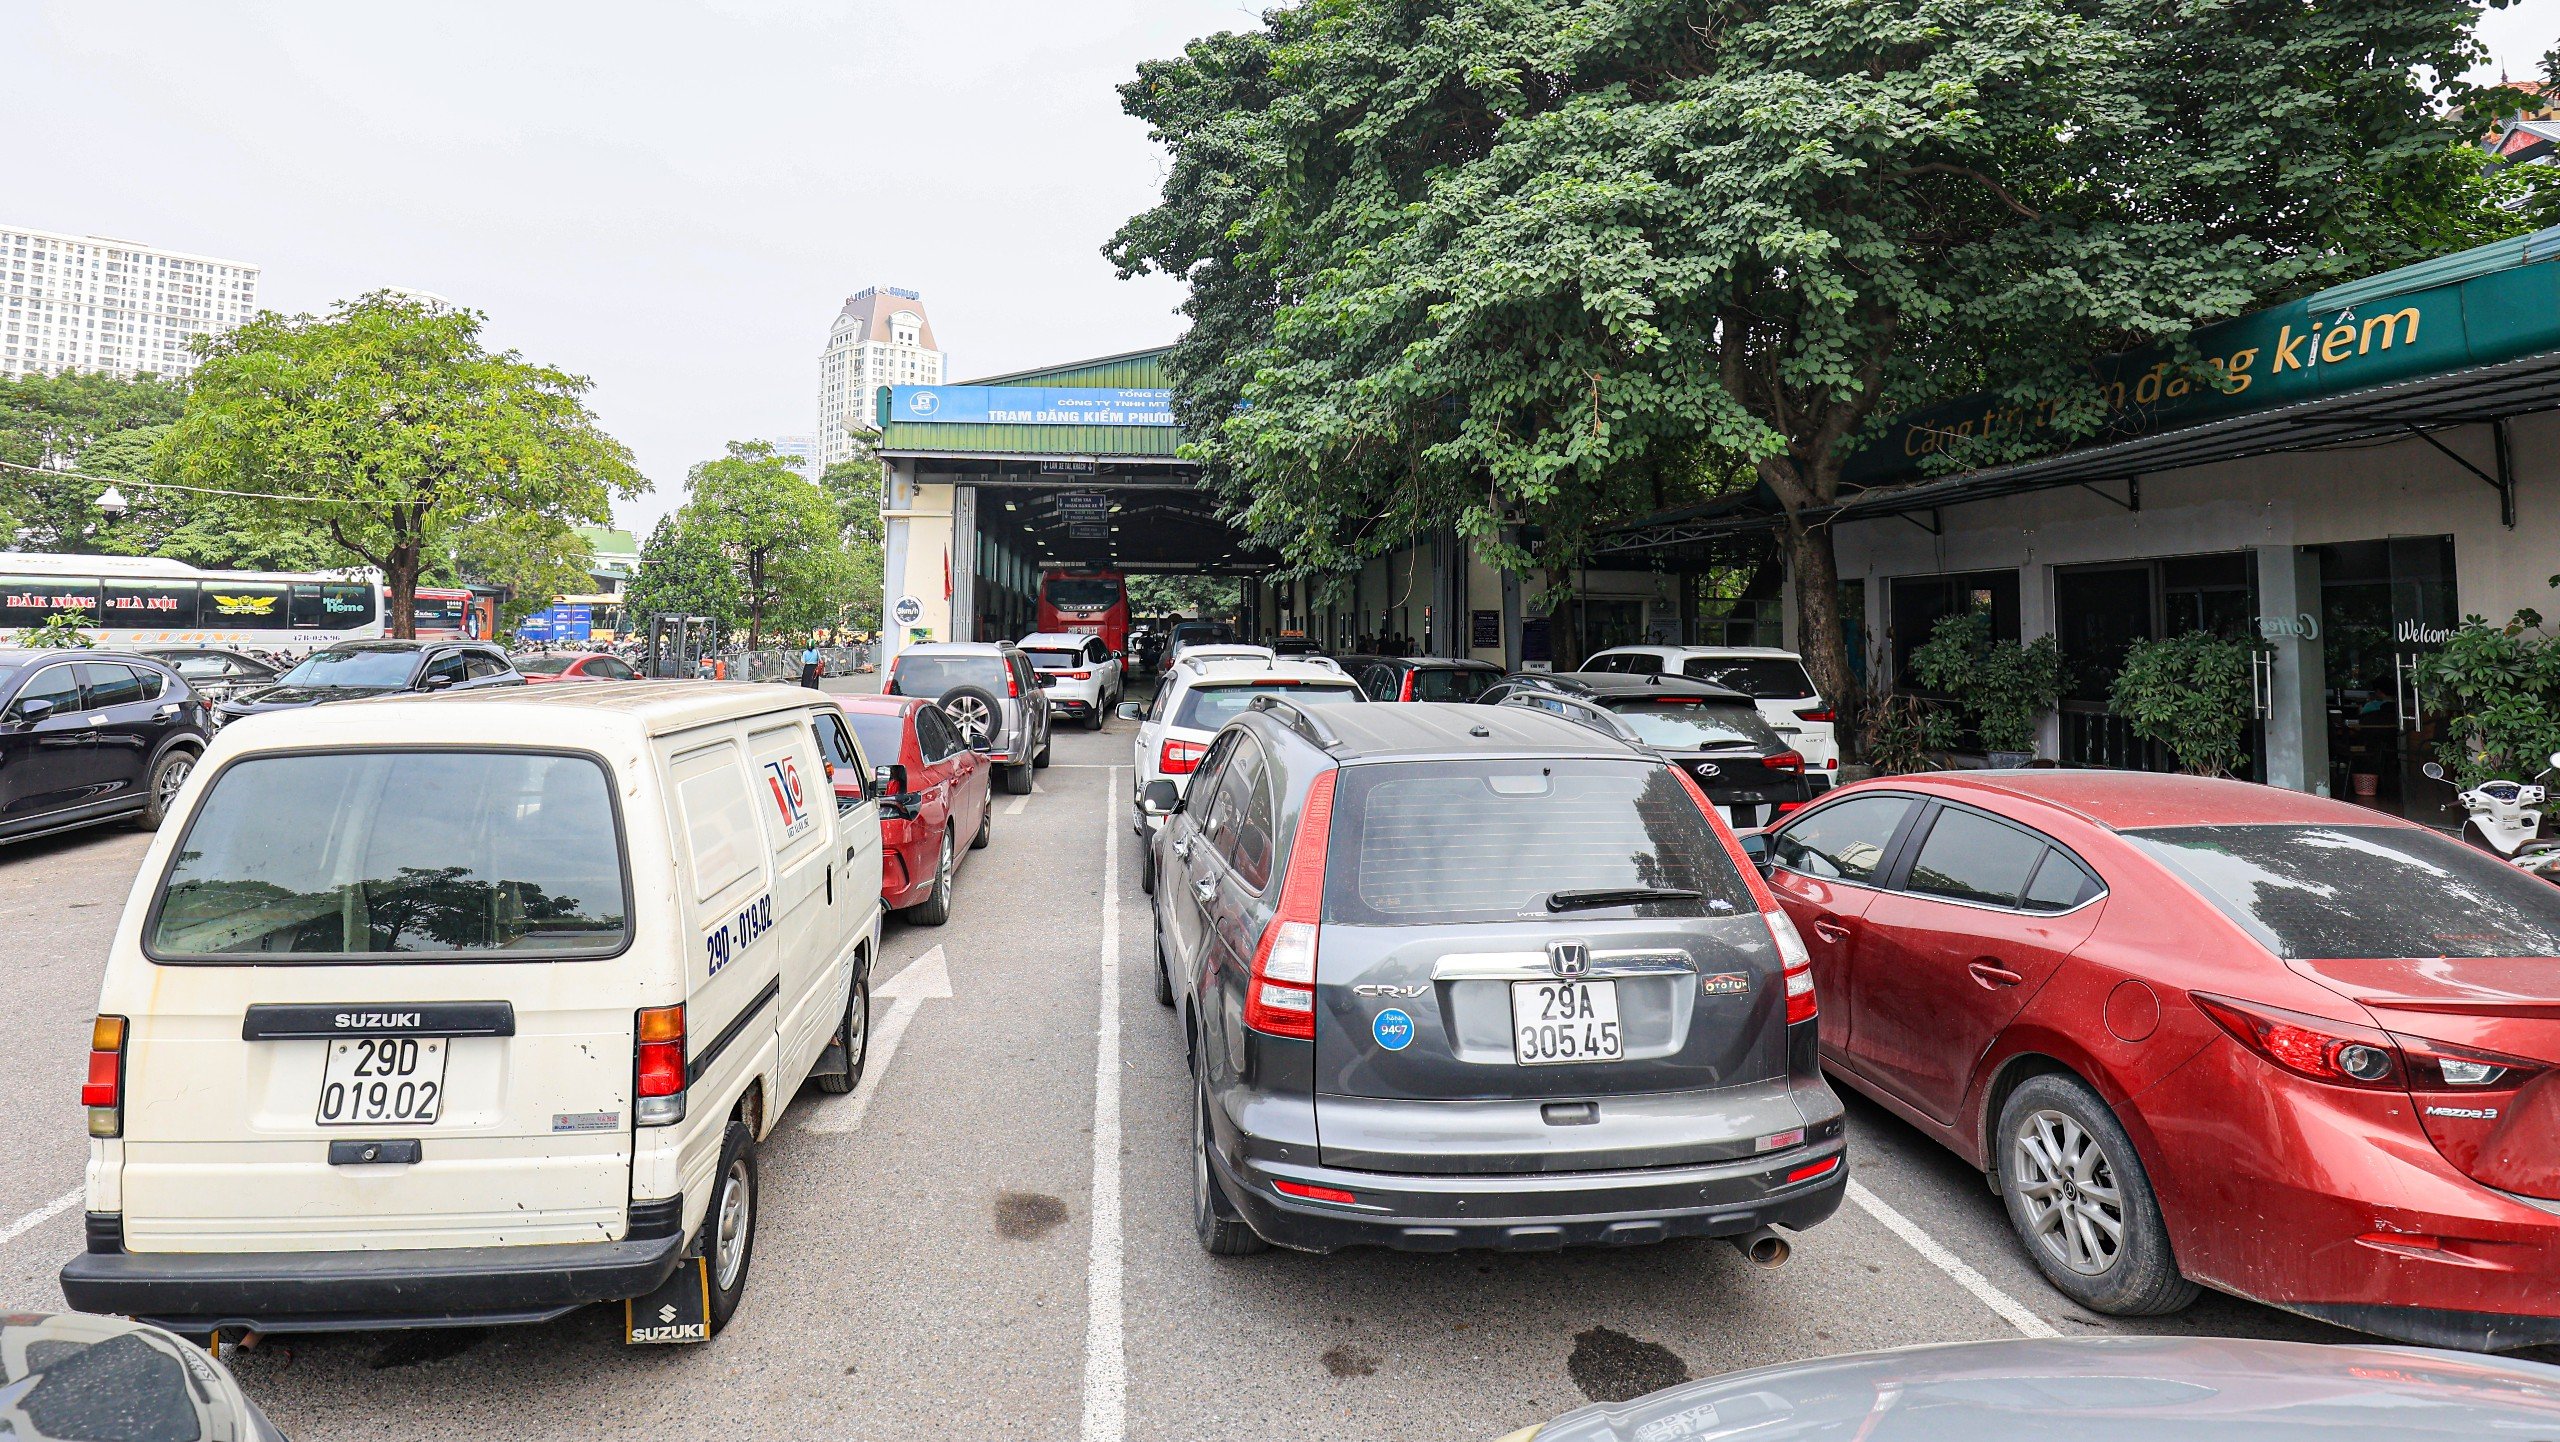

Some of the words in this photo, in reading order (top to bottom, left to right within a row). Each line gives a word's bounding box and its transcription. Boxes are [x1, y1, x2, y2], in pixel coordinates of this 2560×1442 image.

[1058, 398, 1092, 407] CÔNG
[988, 410, 1032, 424] TRẠM
[1037, 408, 1079, 422] ĐĂNG
[1084, 407, 1124, 423] KIỂM
[1128, 411, 1176, 424] PHƯƠ
[51, 593, 96, 608] NÔNG
[116, 595, 144, 609] HÀ
[147, 594, 178, 612] NỘI
[322, 597, 344, 606] New
[326, 602, 365, 613] Home
[706, 925, 731, 977] 29D
[739, 893, 773, 950] 019.02
[1352, 984, 1430, 999] CR-V
[1539, 984, 1595, 1020] 29A
[334, 1012, 421, 1028] SUZUKI
[1520, 1021, 1619, 1060] 305.45
[353, 1038, 419, 1077] 29D
[322, 1080, 438, 1120] 019.02
[631, 1323, 705, 1342] SUZUKI
